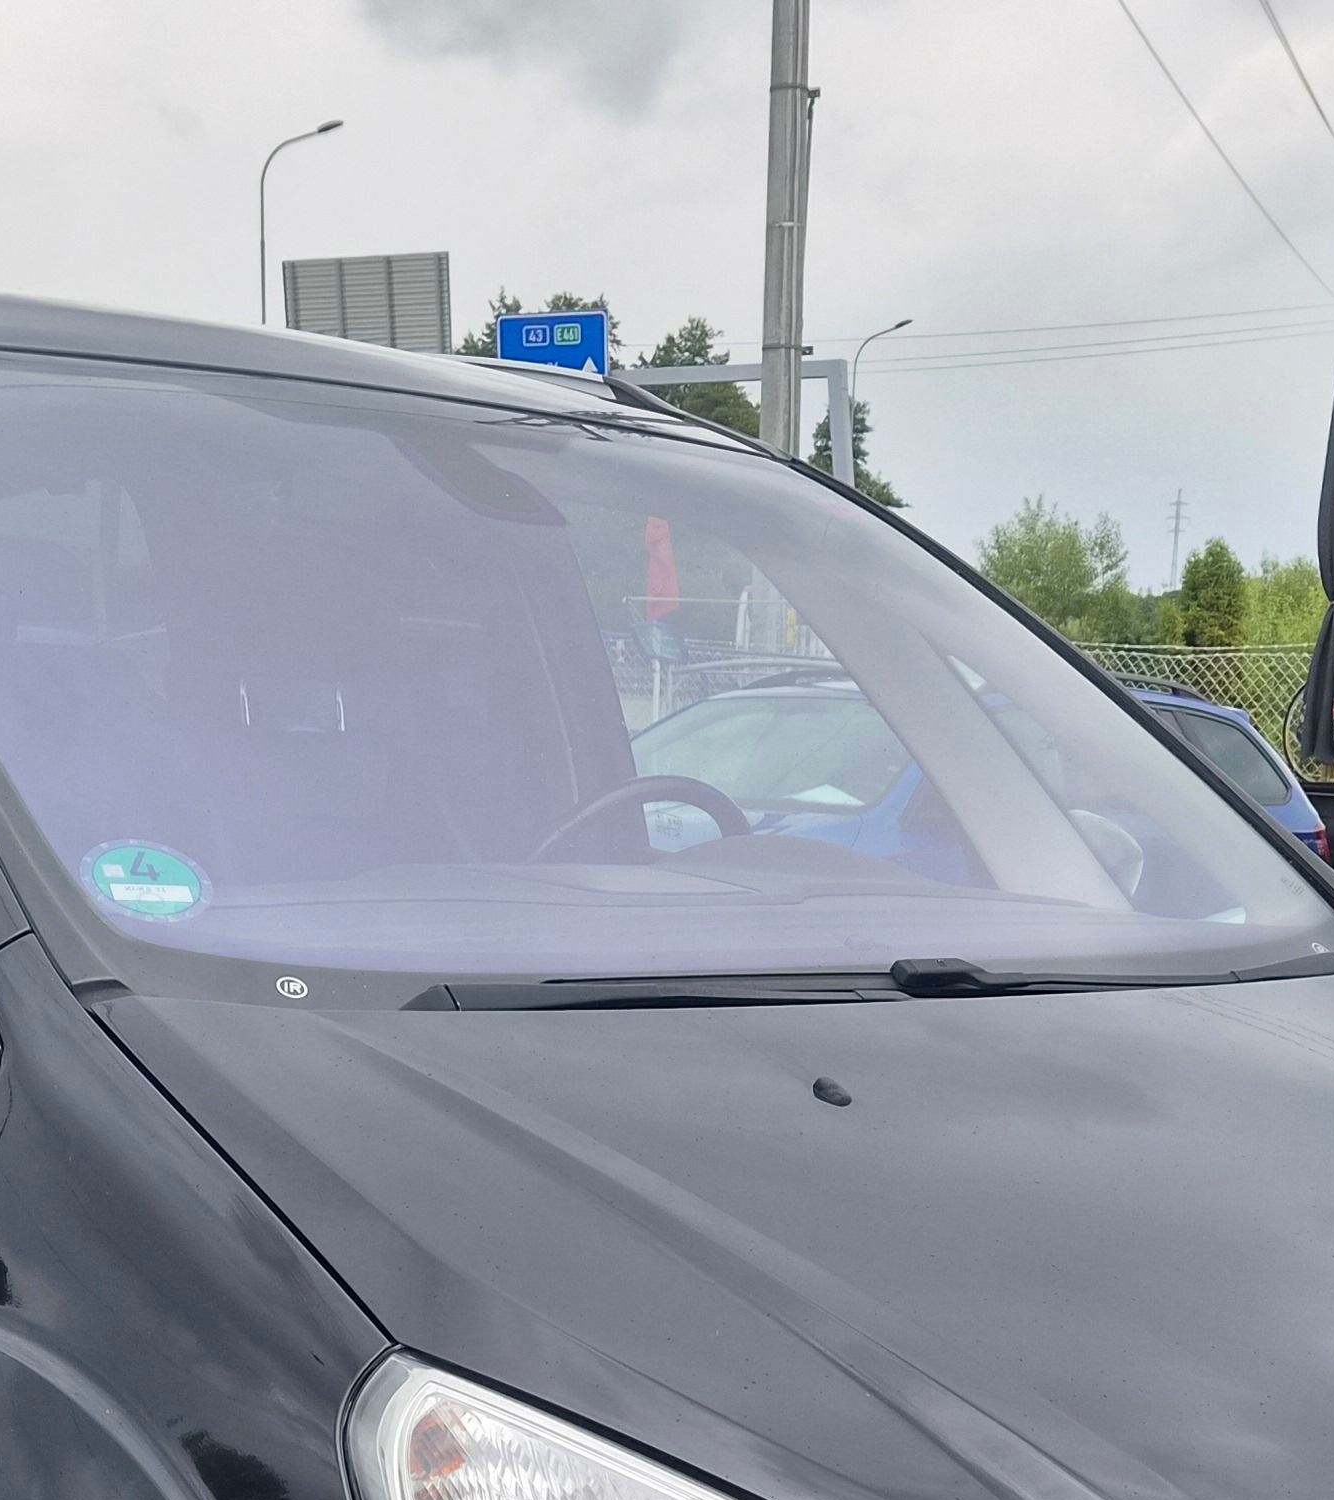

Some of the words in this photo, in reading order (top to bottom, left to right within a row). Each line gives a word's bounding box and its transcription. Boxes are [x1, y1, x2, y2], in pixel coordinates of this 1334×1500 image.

[528, 329, 543, 343] 43
[556, 327, 578, 342] E461
[130, 851, 161, 881] 4
